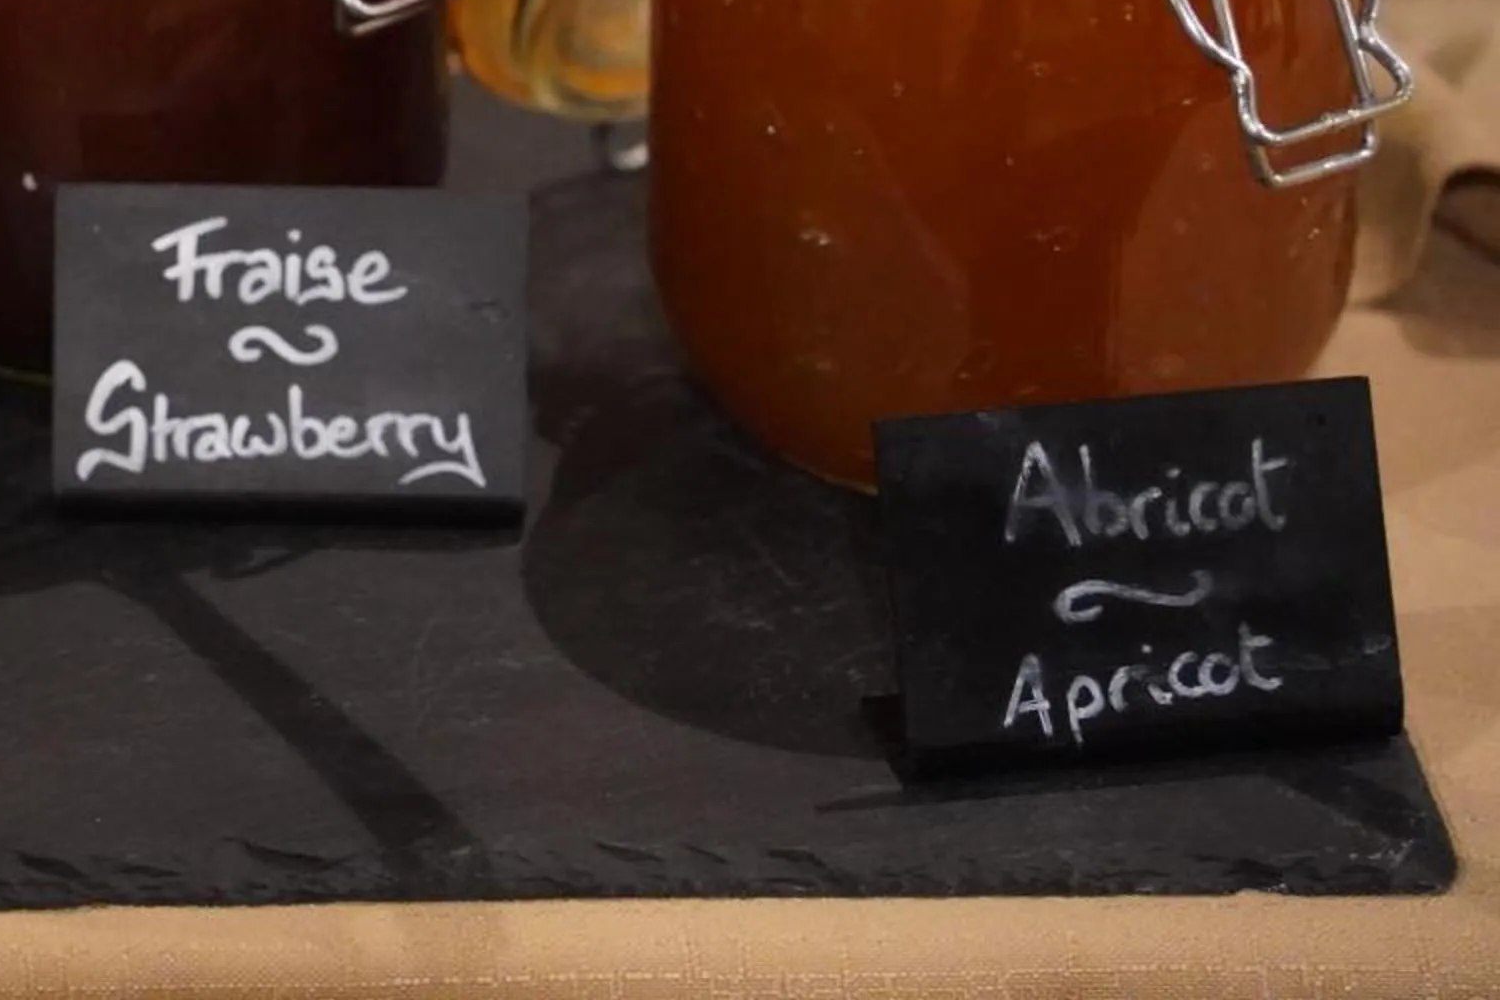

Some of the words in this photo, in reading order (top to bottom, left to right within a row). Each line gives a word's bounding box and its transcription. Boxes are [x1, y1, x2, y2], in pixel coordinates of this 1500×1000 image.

[151, 216, 408, 305] Fraise
[76, 359, 487, 488] Strawberry
[1004, 437, 1290, 546] Abricot
[1002, 622, 1284, 750] Apricot
